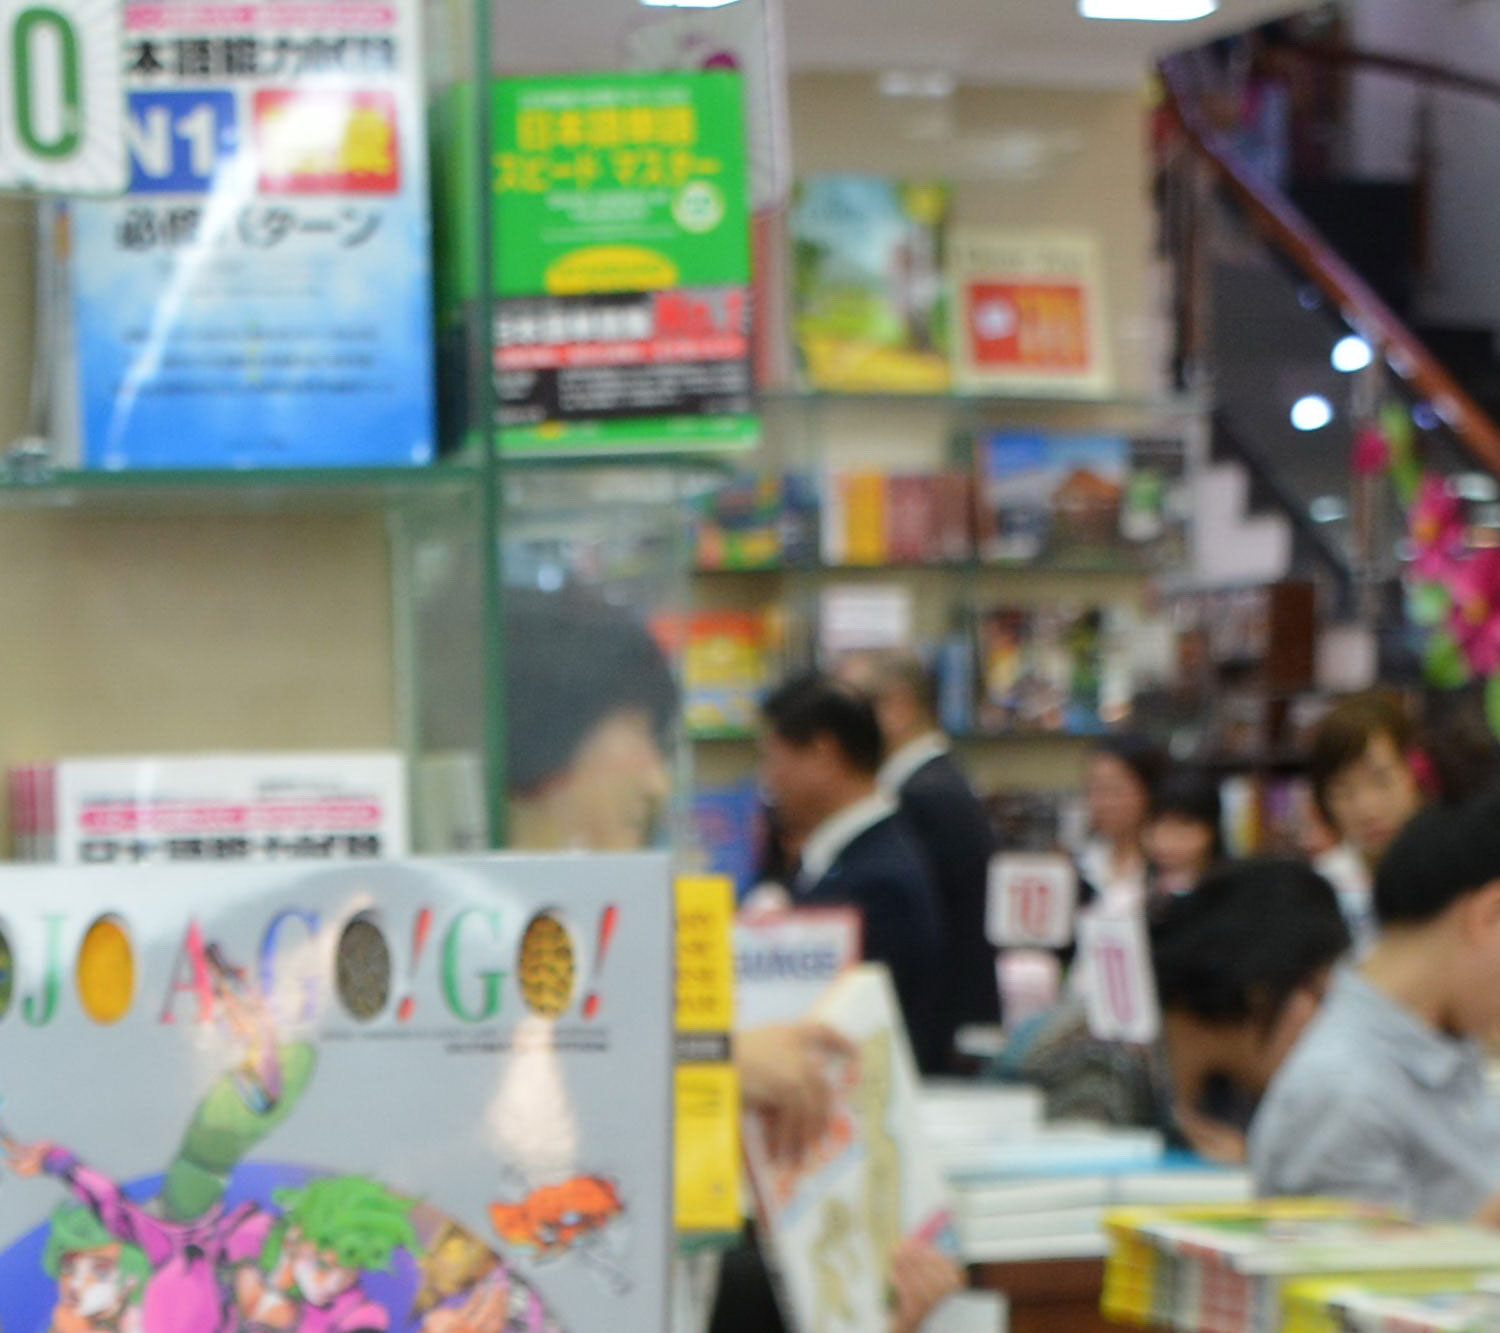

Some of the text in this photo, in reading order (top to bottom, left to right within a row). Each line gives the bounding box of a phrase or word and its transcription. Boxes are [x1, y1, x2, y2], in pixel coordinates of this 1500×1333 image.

[127, 36, 397, 76] 本語能力試験
[125, 104, 217, 179] N1
[116, 205, 383, 250] 必修ターン
